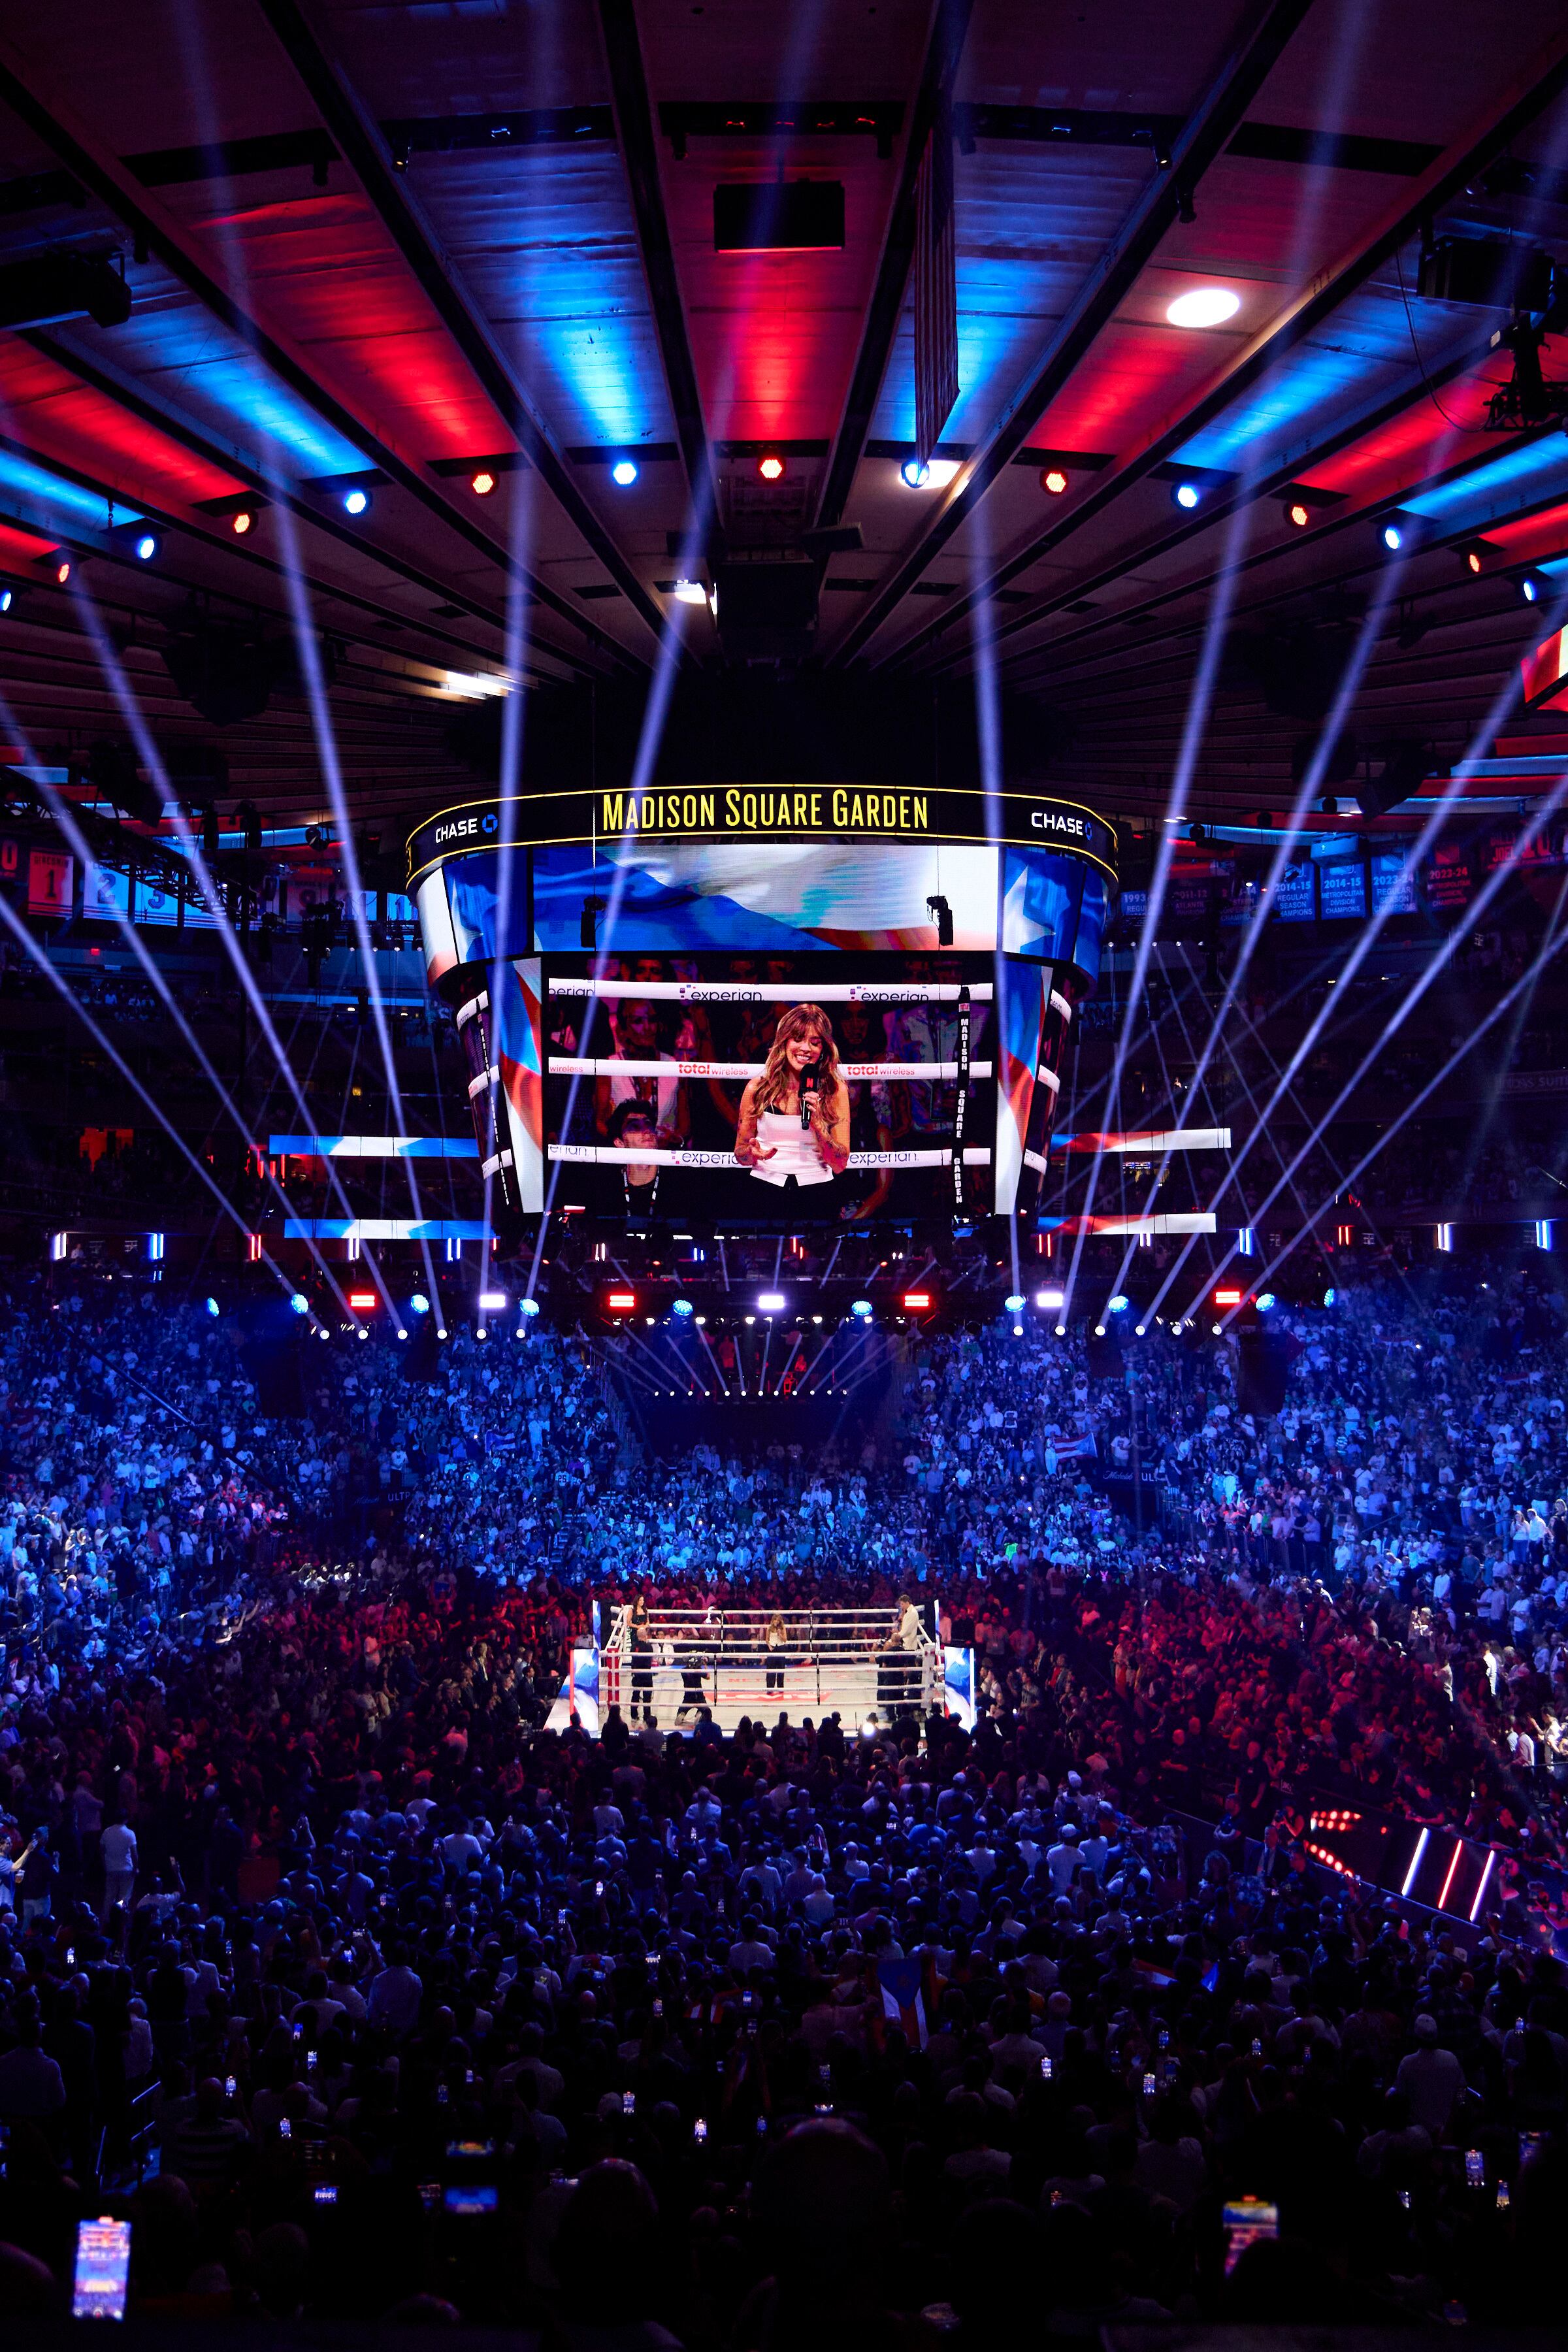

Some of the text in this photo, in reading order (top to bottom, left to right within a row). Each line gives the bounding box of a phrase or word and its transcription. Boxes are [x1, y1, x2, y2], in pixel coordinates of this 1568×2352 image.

[603, 789, 928, 831] MADISON SQUARE GARDEN
[435, 818, 478, 843] CHASE
[1031, 812, 1083, 836] CHASE
[1429, 866, 1468, 879] 2023-24
[46, 869, 57, 898] 1
[1324, 877, 1361, 889] 2014-15
[1373, 874, 1414, 885] 2023-24
[97, 873, 116, 904] 2
[1275, 881, 1311, 892] 2014-15
[1377, 887, 1411, 895] REGULAR
[1277, 893, 1309, 902] REGULAR
[1321, 889, 1364, 898] METROPOLITAN
[1380, 895, 1409, 904] SEASON
[691, 988, 762, 1001] experian
[861, 990, 929, 1001] experian
[960, 1019, 969, 1070] MADISON
[679, 1064, 748, 1075] total wireless
[847, 1066, 915, 1075] total wireless
[956, 1090, 966, 1138] SQUARE
[682, 1152, 739, 1165] experi
[849, 1150, 917, 1166] experian
[954, 1158, 962, 1203] GARDEN
